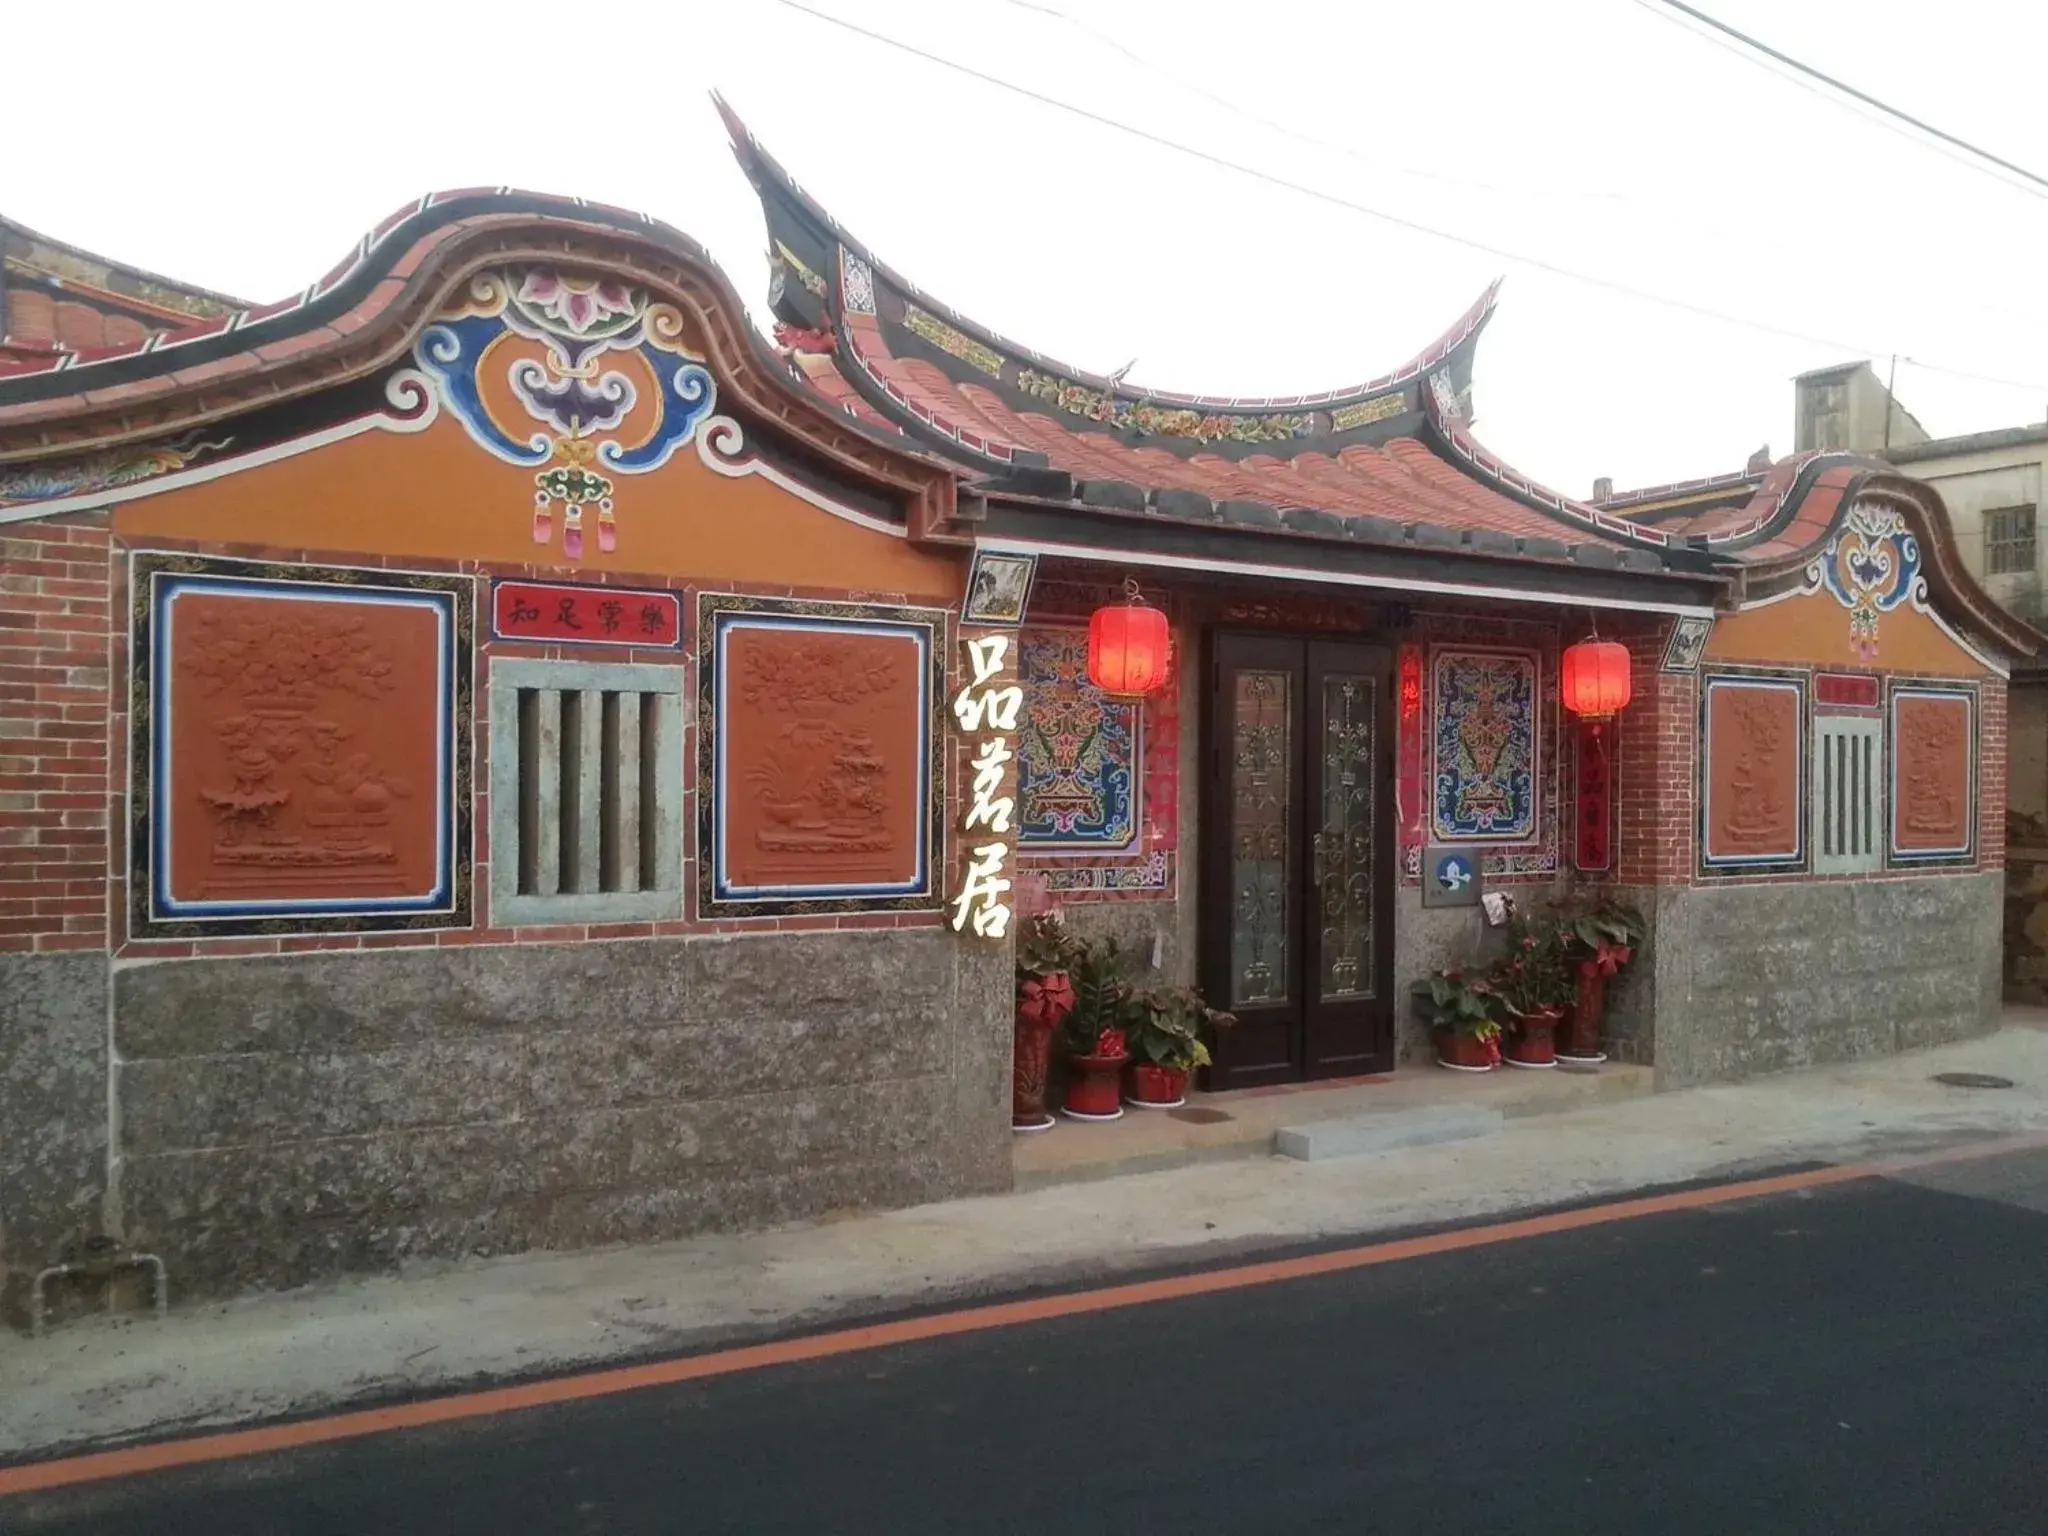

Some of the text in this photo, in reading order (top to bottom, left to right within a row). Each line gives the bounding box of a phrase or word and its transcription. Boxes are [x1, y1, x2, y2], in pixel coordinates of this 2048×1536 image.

[507, 597, 667, 635] 知足常樂
[952, 635, 1024, 938] 品茗居
